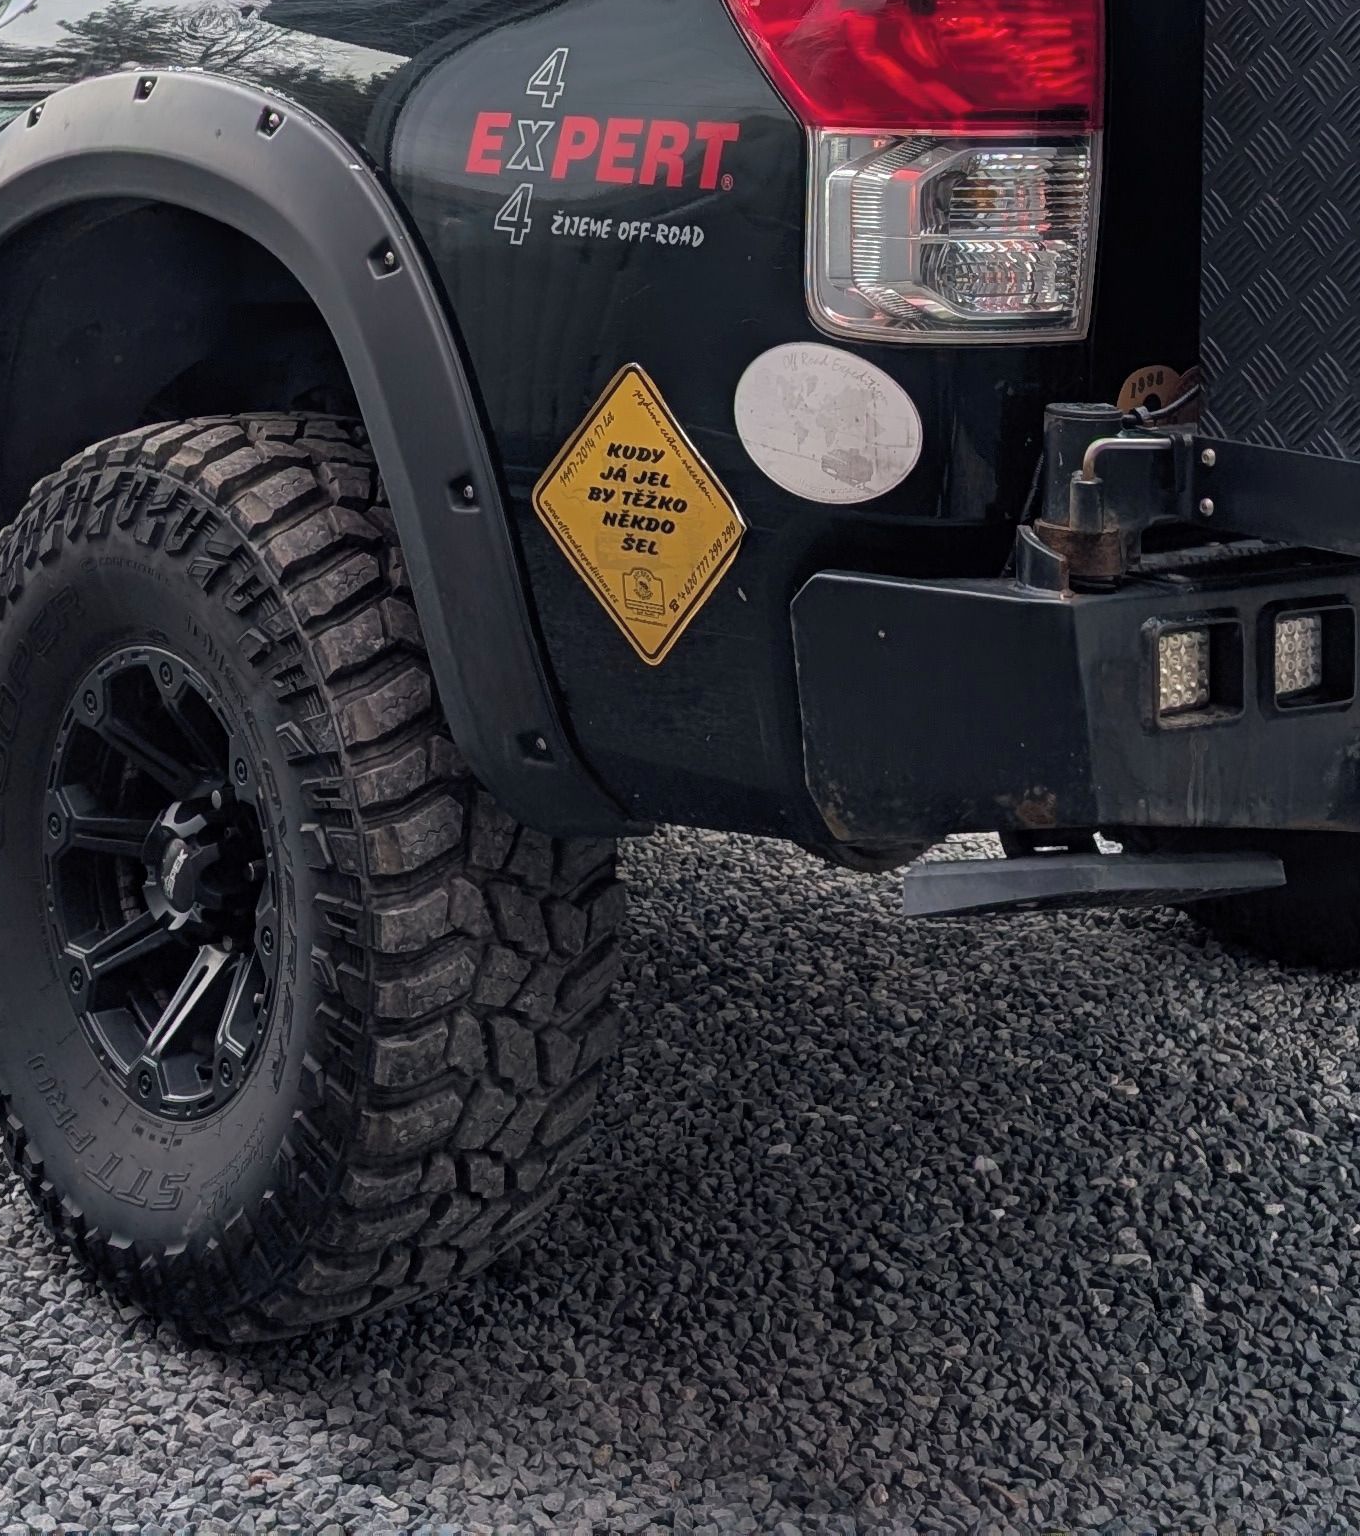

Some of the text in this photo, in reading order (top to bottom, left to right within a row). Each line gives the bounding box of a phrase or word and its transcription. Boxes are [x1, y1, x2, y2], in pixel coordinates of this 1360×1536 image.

[526, 47, 569, 109] 4
[494, 182, 534, 246] 4
[551, 209, 705, 249] ŽIJEME OFF-ROAD
[607, 442, 666, 464] KUDY
[600, 464, 671, 488] JÁ JEL
[588, 486, 688, 513] BY TĚŽKO
[602, 509, 676, 534] NĚKDO
[621, 532, 659, 555] ŠEL
[83, 1152, 191, 1212] STT
